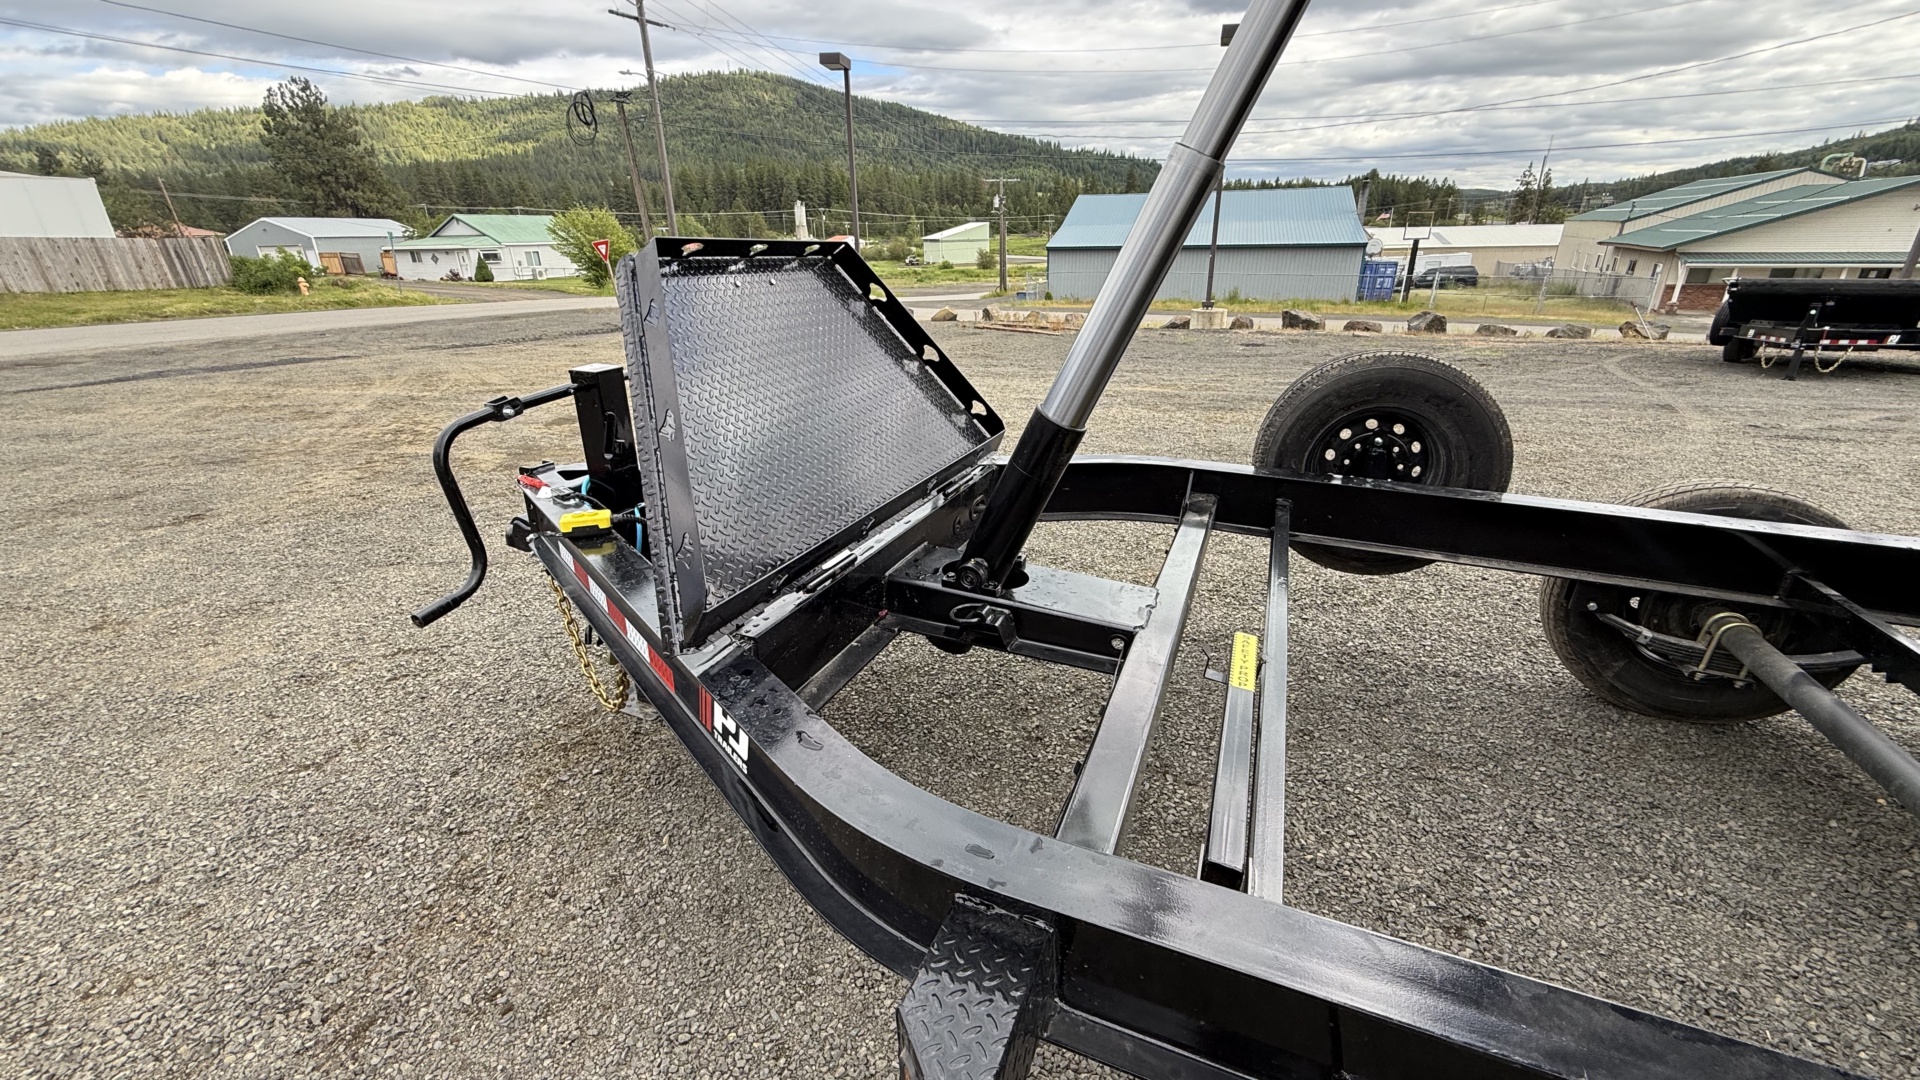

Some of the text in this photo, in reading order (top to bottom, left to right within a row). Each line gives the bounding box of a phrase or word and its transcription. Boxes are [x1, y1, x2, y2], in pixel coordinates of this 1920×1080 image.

[1238, 665, 1249, 687] PROP
[713, 729, 748, 775] TRAILERS
[714, 700, 749, 761] PJ
